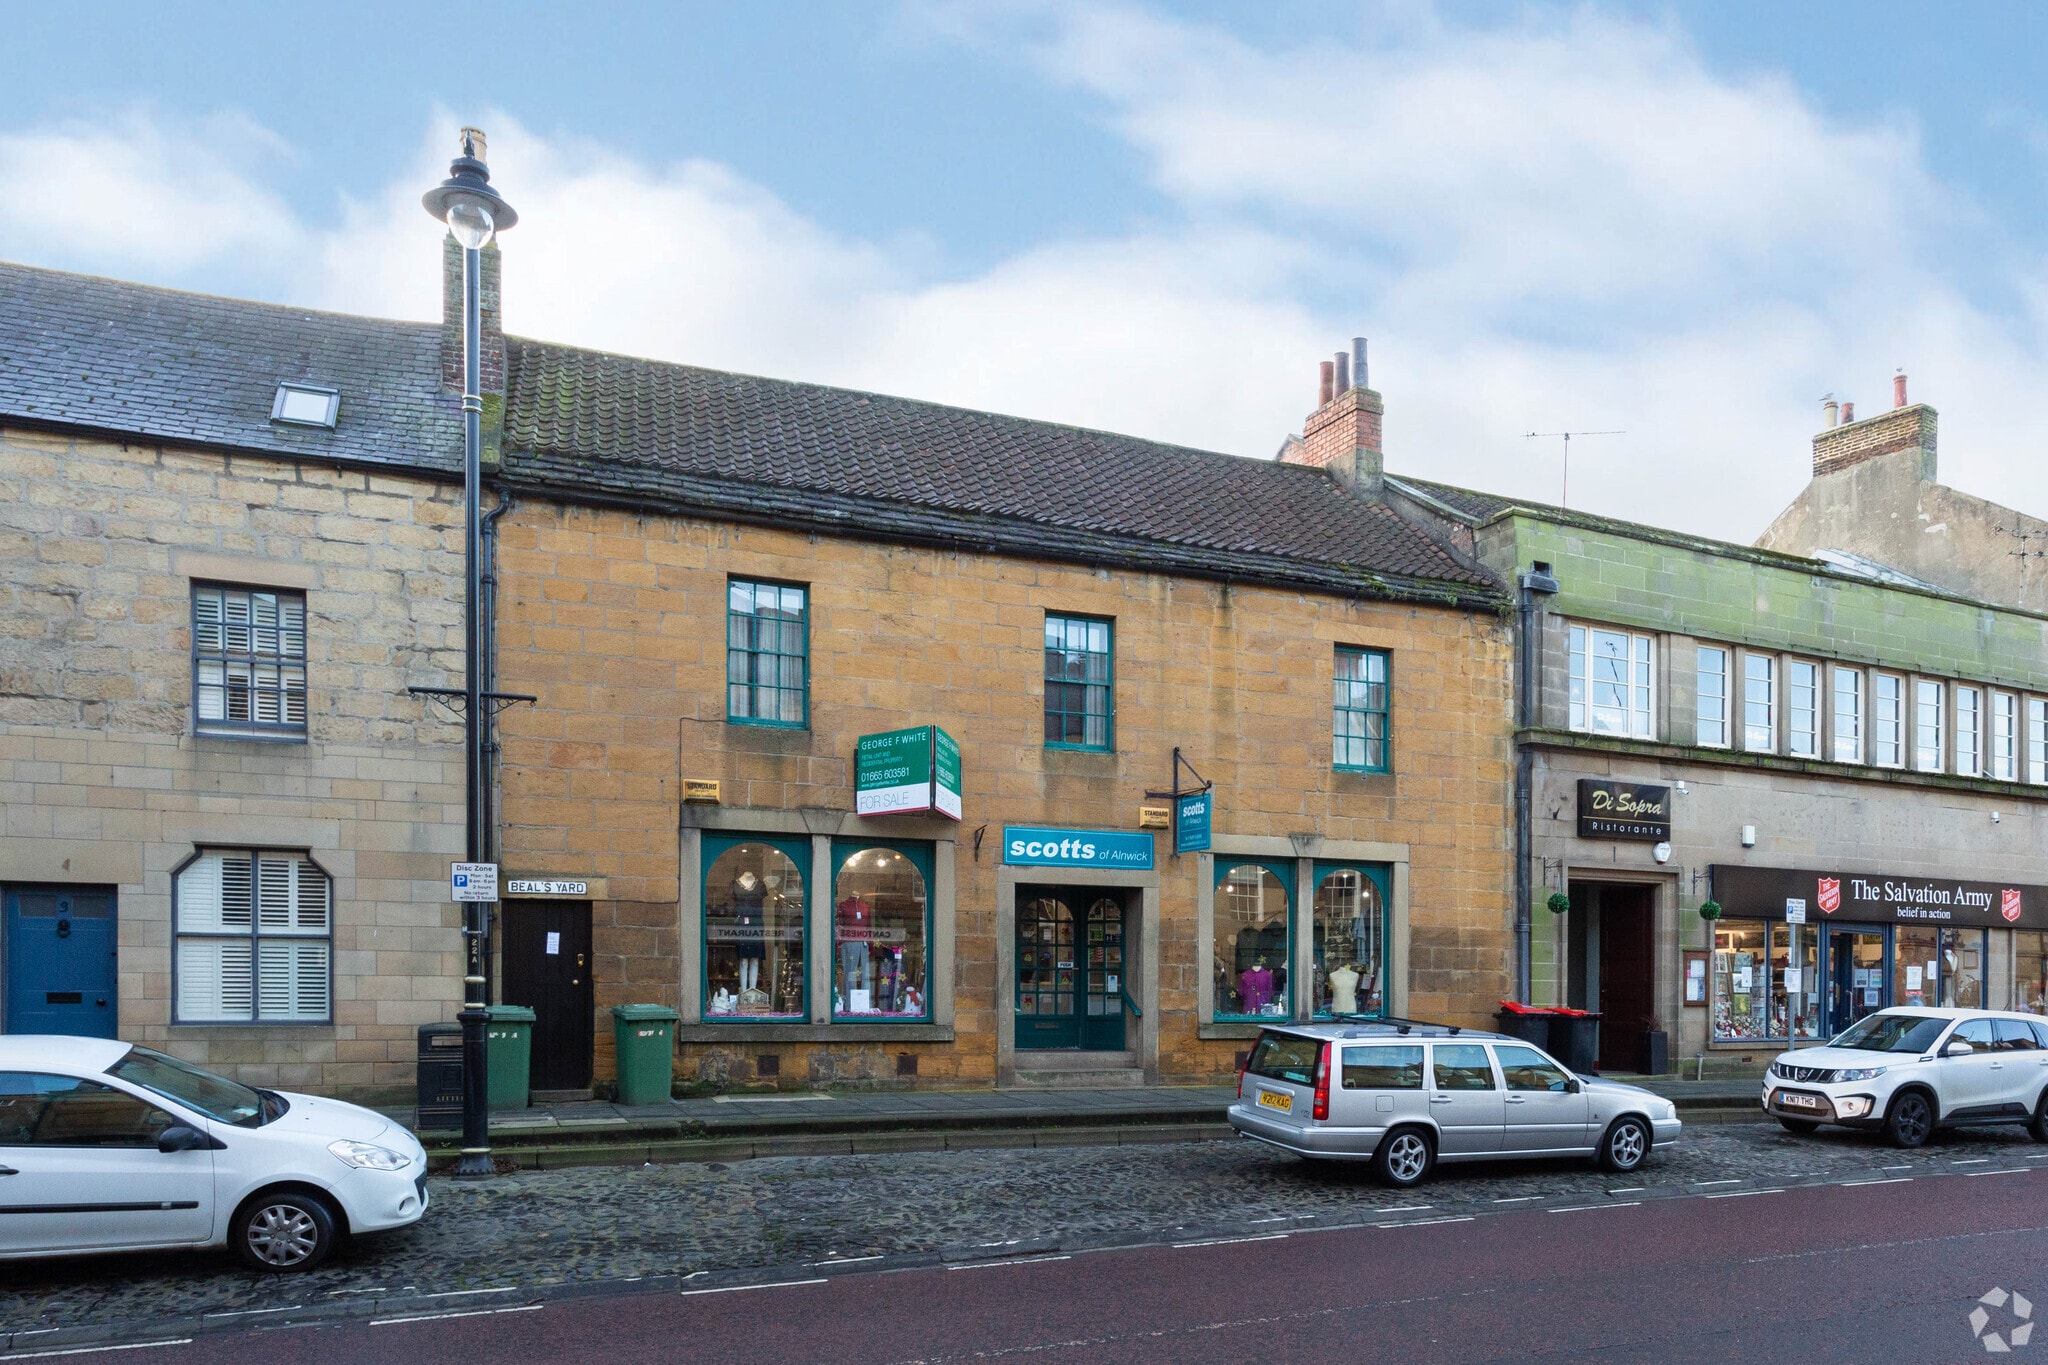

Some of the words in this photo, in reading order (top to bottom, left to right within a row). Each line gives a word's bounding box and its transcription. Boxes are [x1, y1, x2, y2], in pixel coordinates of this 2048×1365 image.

[861, 737, 893, 750] GEORGE
[895, 736, 900, 745] F
[901, 732, 927, 744] WHITE
[861, 770, 883, 782] 01665
[884, 767, 910, 780] 603581
[687, 782, 717, 790] STANDARD
[860, 794, 881, 811] FOR
[883, 791, 910, 807] SALE
[1592, 790, 1614, 810] Di
[1616, 793, 1662, 817] Sopra
[1183, 802, 1205, 817] scotts
[1592, 822, 1662, 835] Ristorante
[1010, 839, 1096, 859] scotts
[1099, 851, 1110, 860] of
[1111, 850, 1148, 861] Alnwick
[456, 875, 466, 886] P
[511, 882, 552, 892] BEAL'S
[556, 883, 584, 893] YARD
[1851, 879, 1880, 900] The
[1884, 881, 1951, 905] Salvation
[1953, 886, 1993, 912] Army
[1897, 906, 1919, 918] belief
[1920, 908, 1927, 918] in
[1929, 908, 1950, 919] action
